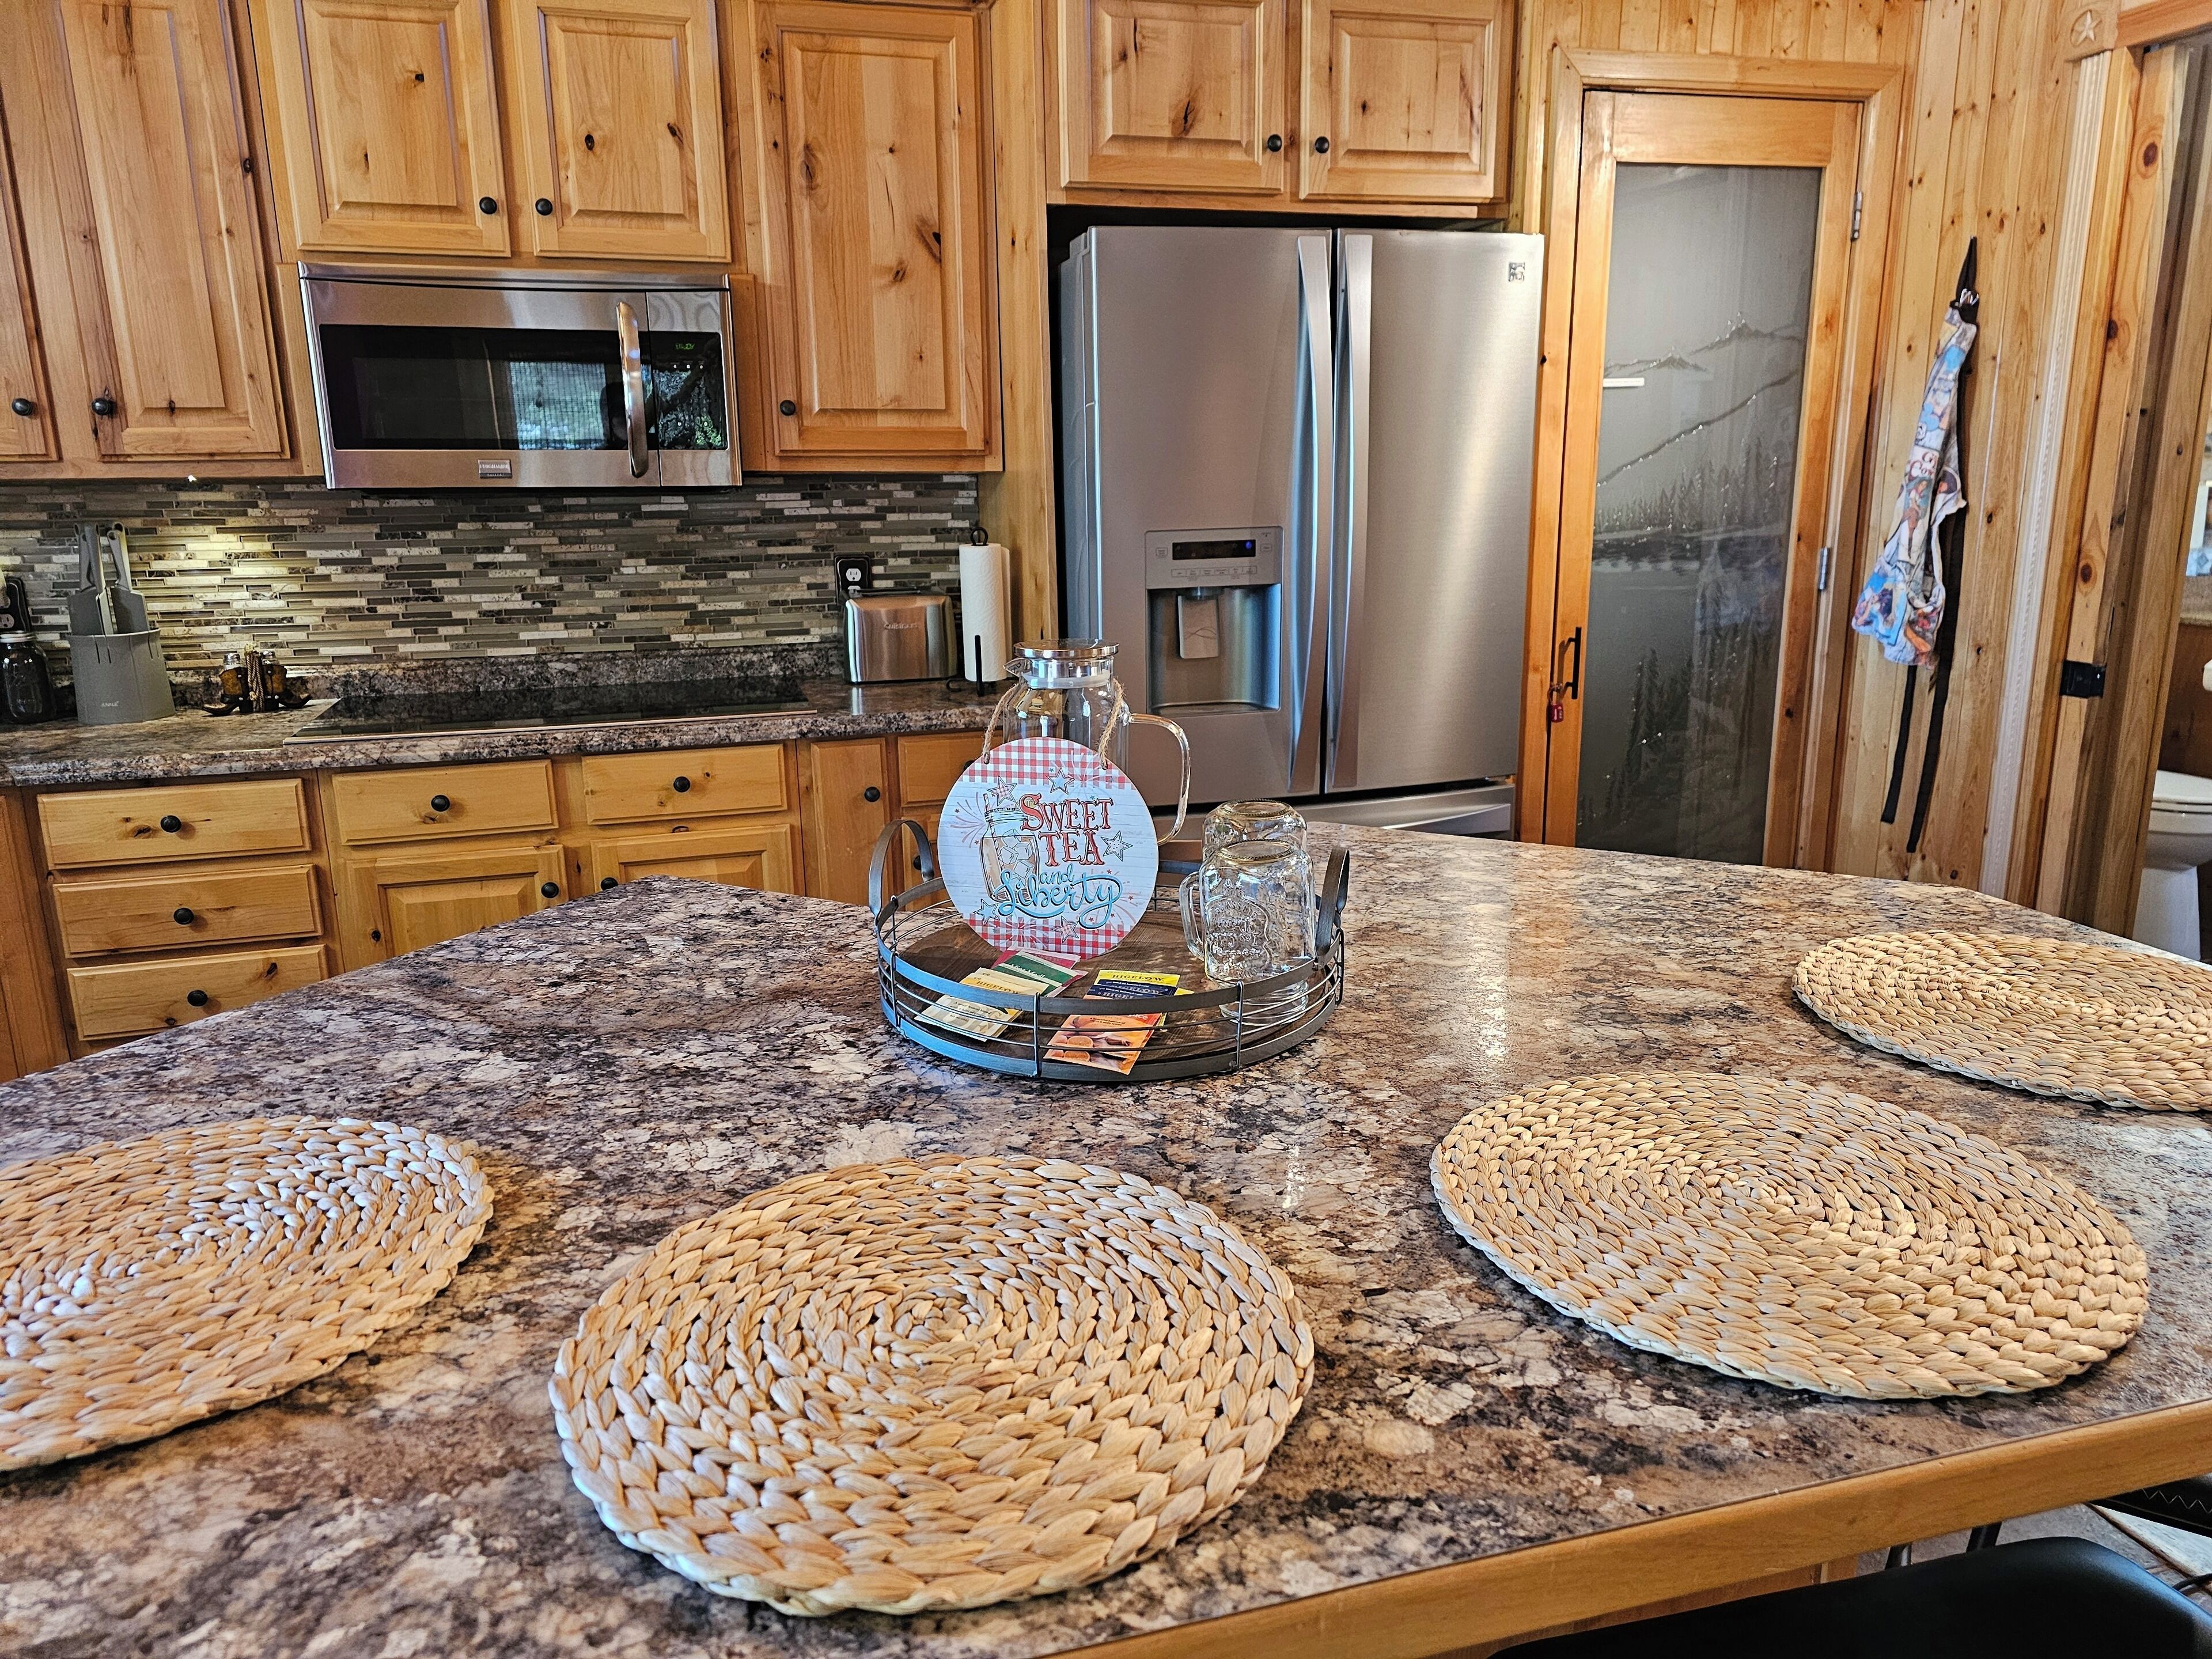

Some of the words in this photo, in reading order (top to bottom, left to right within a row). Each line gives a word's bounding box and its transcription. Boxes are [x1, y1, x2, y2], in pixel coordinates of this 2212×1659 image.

[1018, 793, 1114, 831] SWEET
[1038, 830, 1106, 866] TEA
[1039, 864, 1075, 885] and
[992, 869, 1123, 930] Liberty
